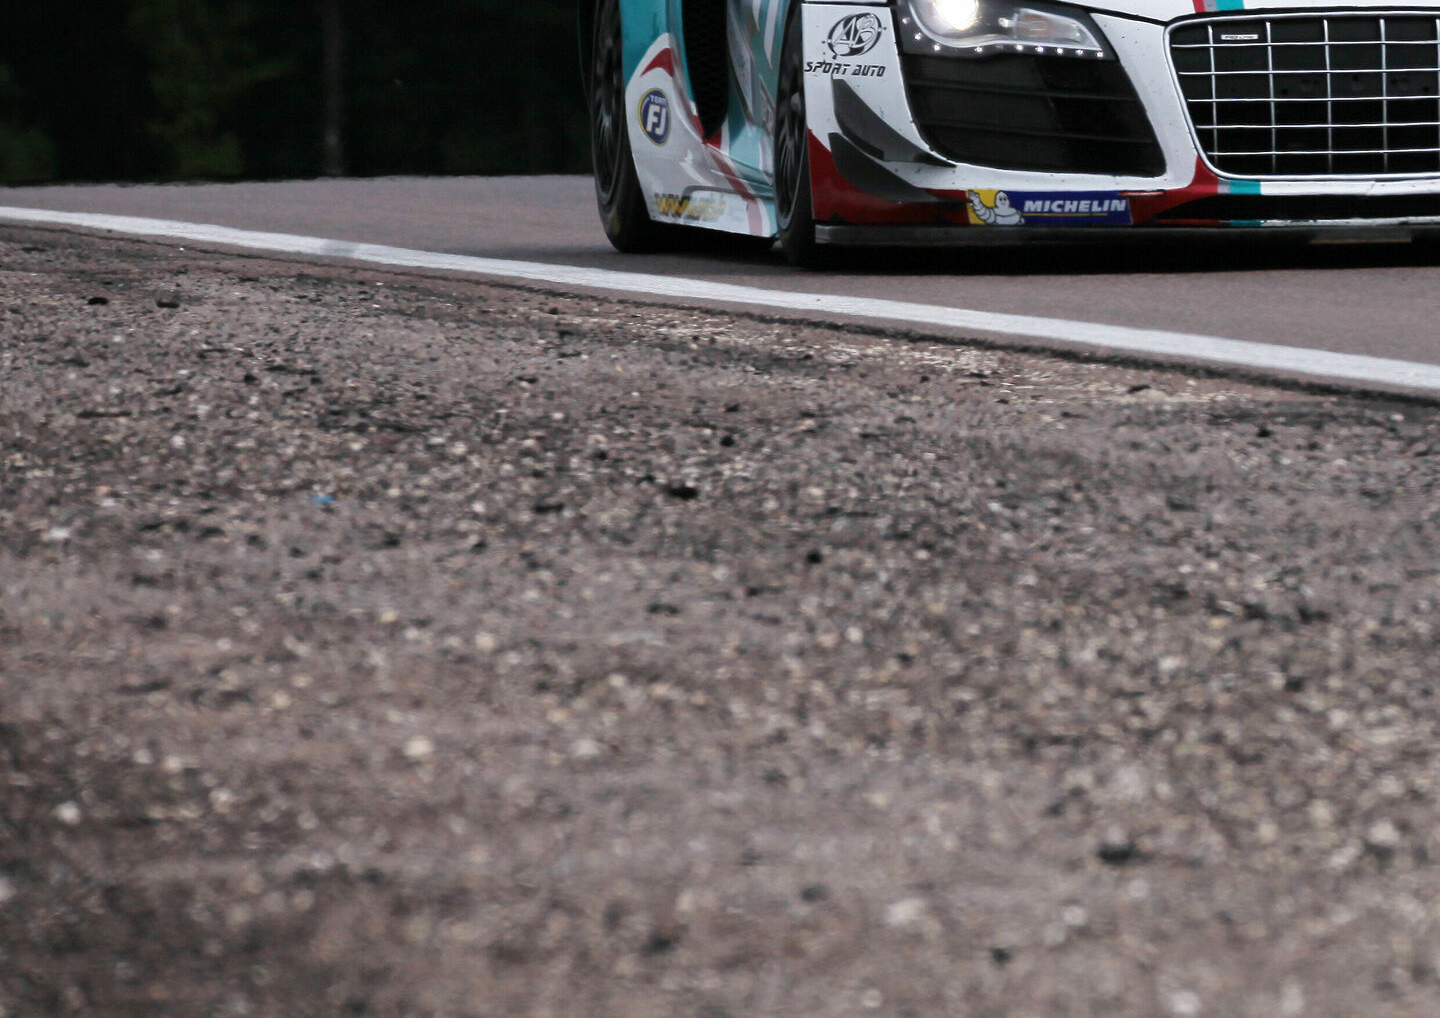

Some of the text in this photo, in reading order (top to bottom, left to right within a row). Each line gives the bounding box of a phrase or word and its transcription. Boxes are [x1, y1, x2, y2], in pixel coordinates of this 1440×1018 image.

[804, 61, 887, 77] SPORT AUTO
[646, 103, 668, 136] FJ
[1023, 199, 1127, 213] MICHELIN
